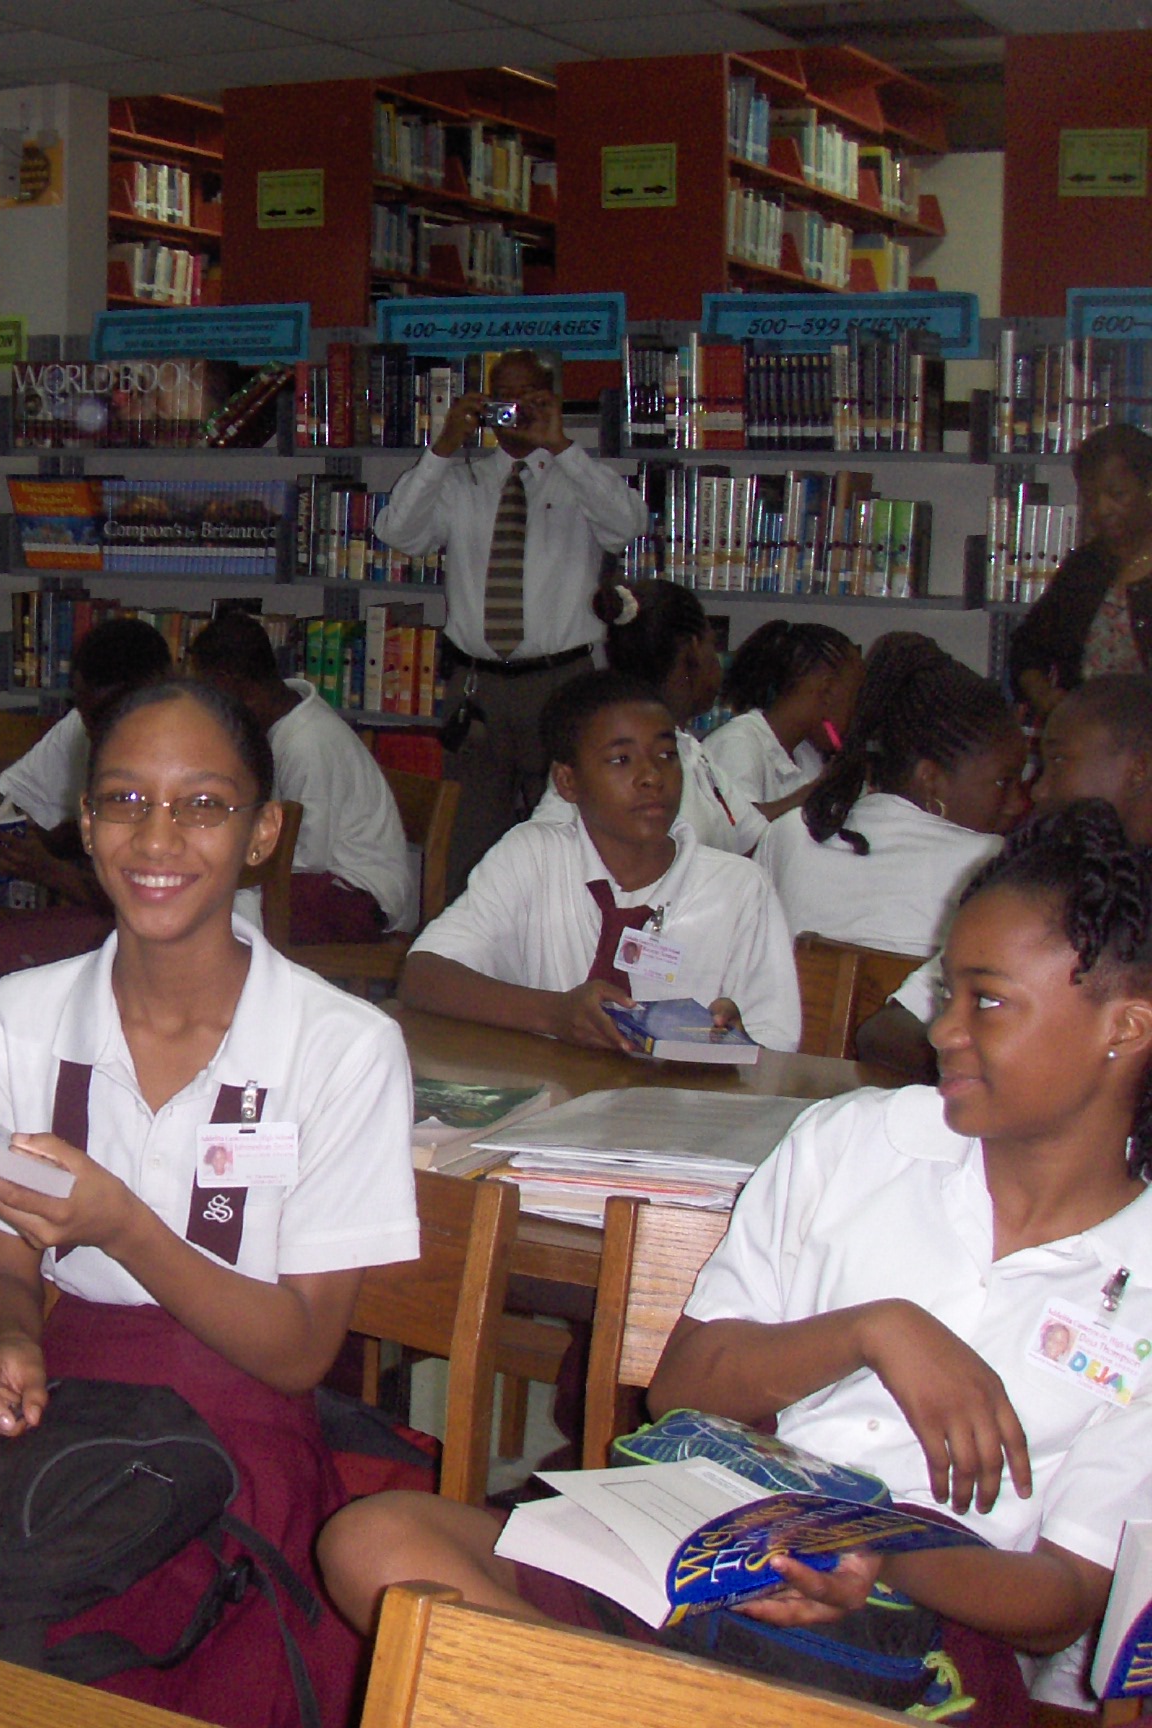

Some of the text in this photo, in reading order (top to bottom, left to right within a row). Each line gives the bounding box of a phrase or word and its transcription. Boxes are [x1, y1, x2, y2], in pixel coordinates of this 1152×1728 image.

[402, 319, 601, 338] 400-499 LANGUAGES
[748, 316, 840, 335] 500-599
[13, 361, 204, 394] WORLD BOOK
[103, 519, 182, 542] Compton's
[200, 520, 277, 540] Britannica
